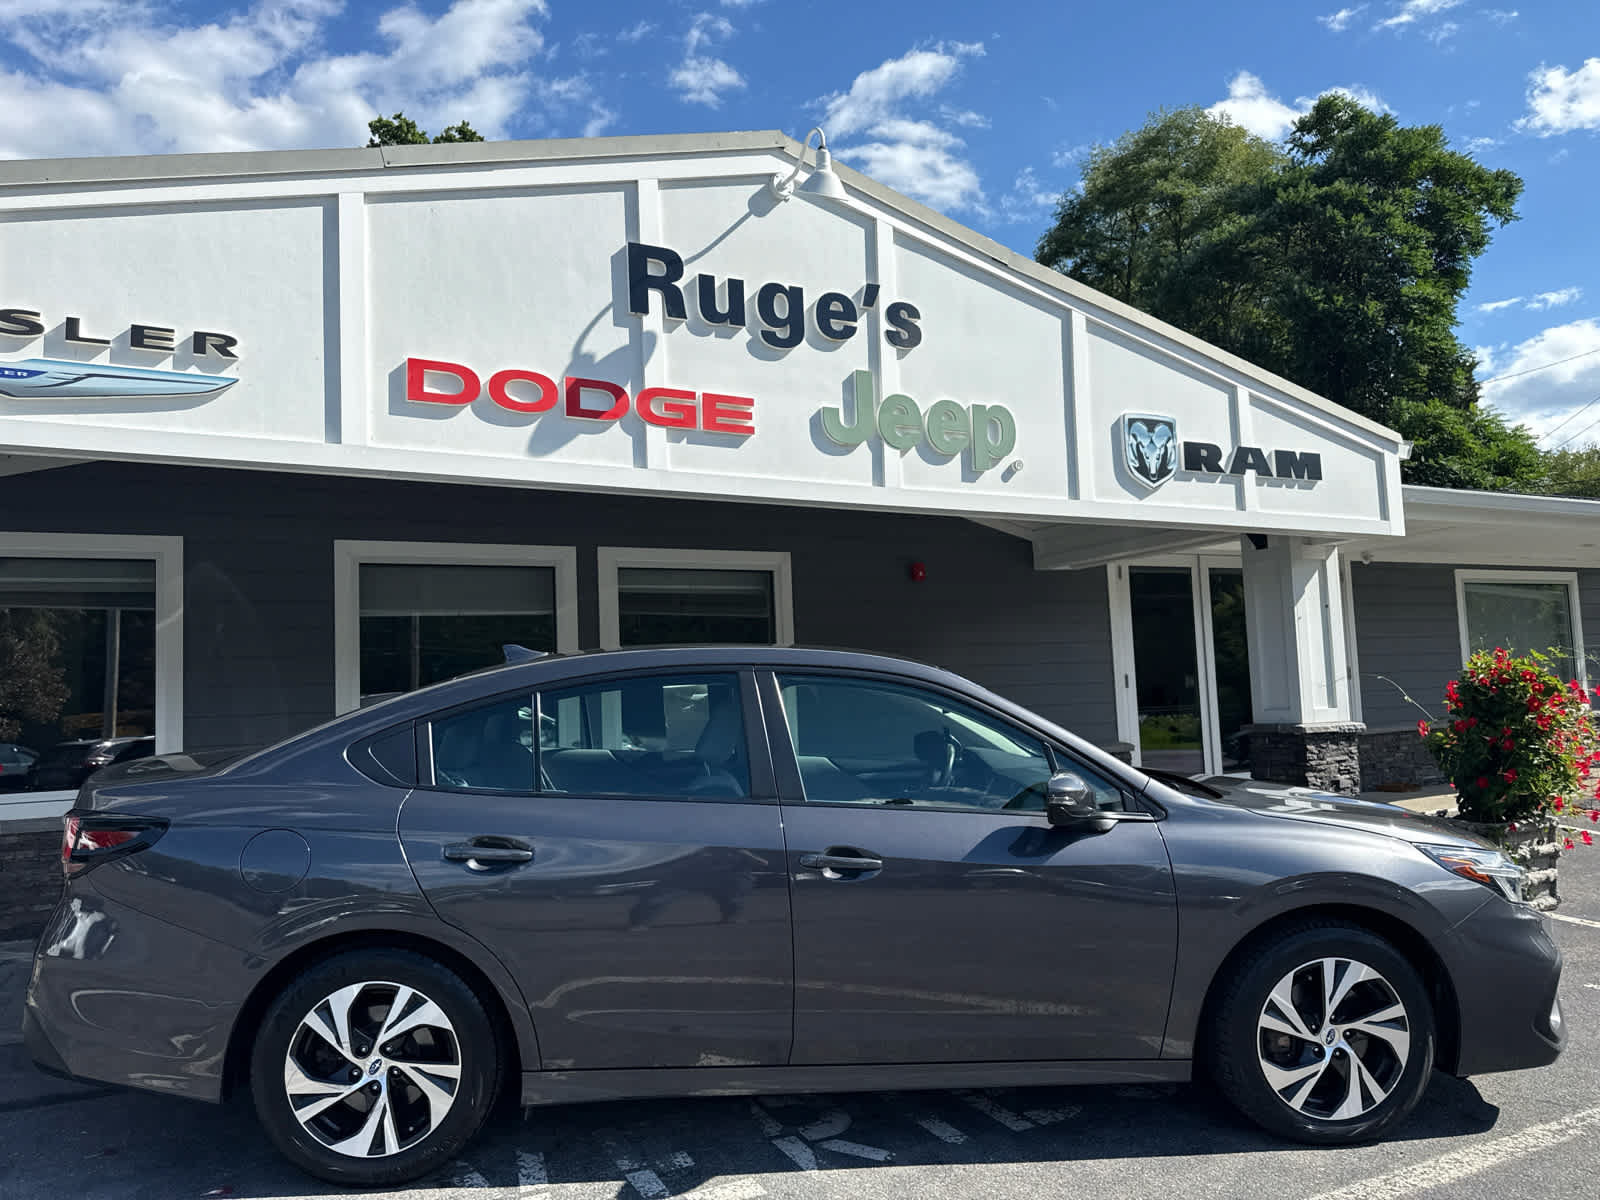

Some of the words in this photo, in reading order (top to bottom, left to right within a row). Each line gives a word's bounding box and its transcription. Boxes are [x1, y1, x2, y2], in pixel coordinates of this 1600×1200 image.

[0, 309, 239, 358] SLER
[627, 242, 922, 349] Ruge's
[406, 357, 756, 436] DODGE
[822, 369, 1017, 473] Jeep
[1183, 441, 1322, 480] RAM
